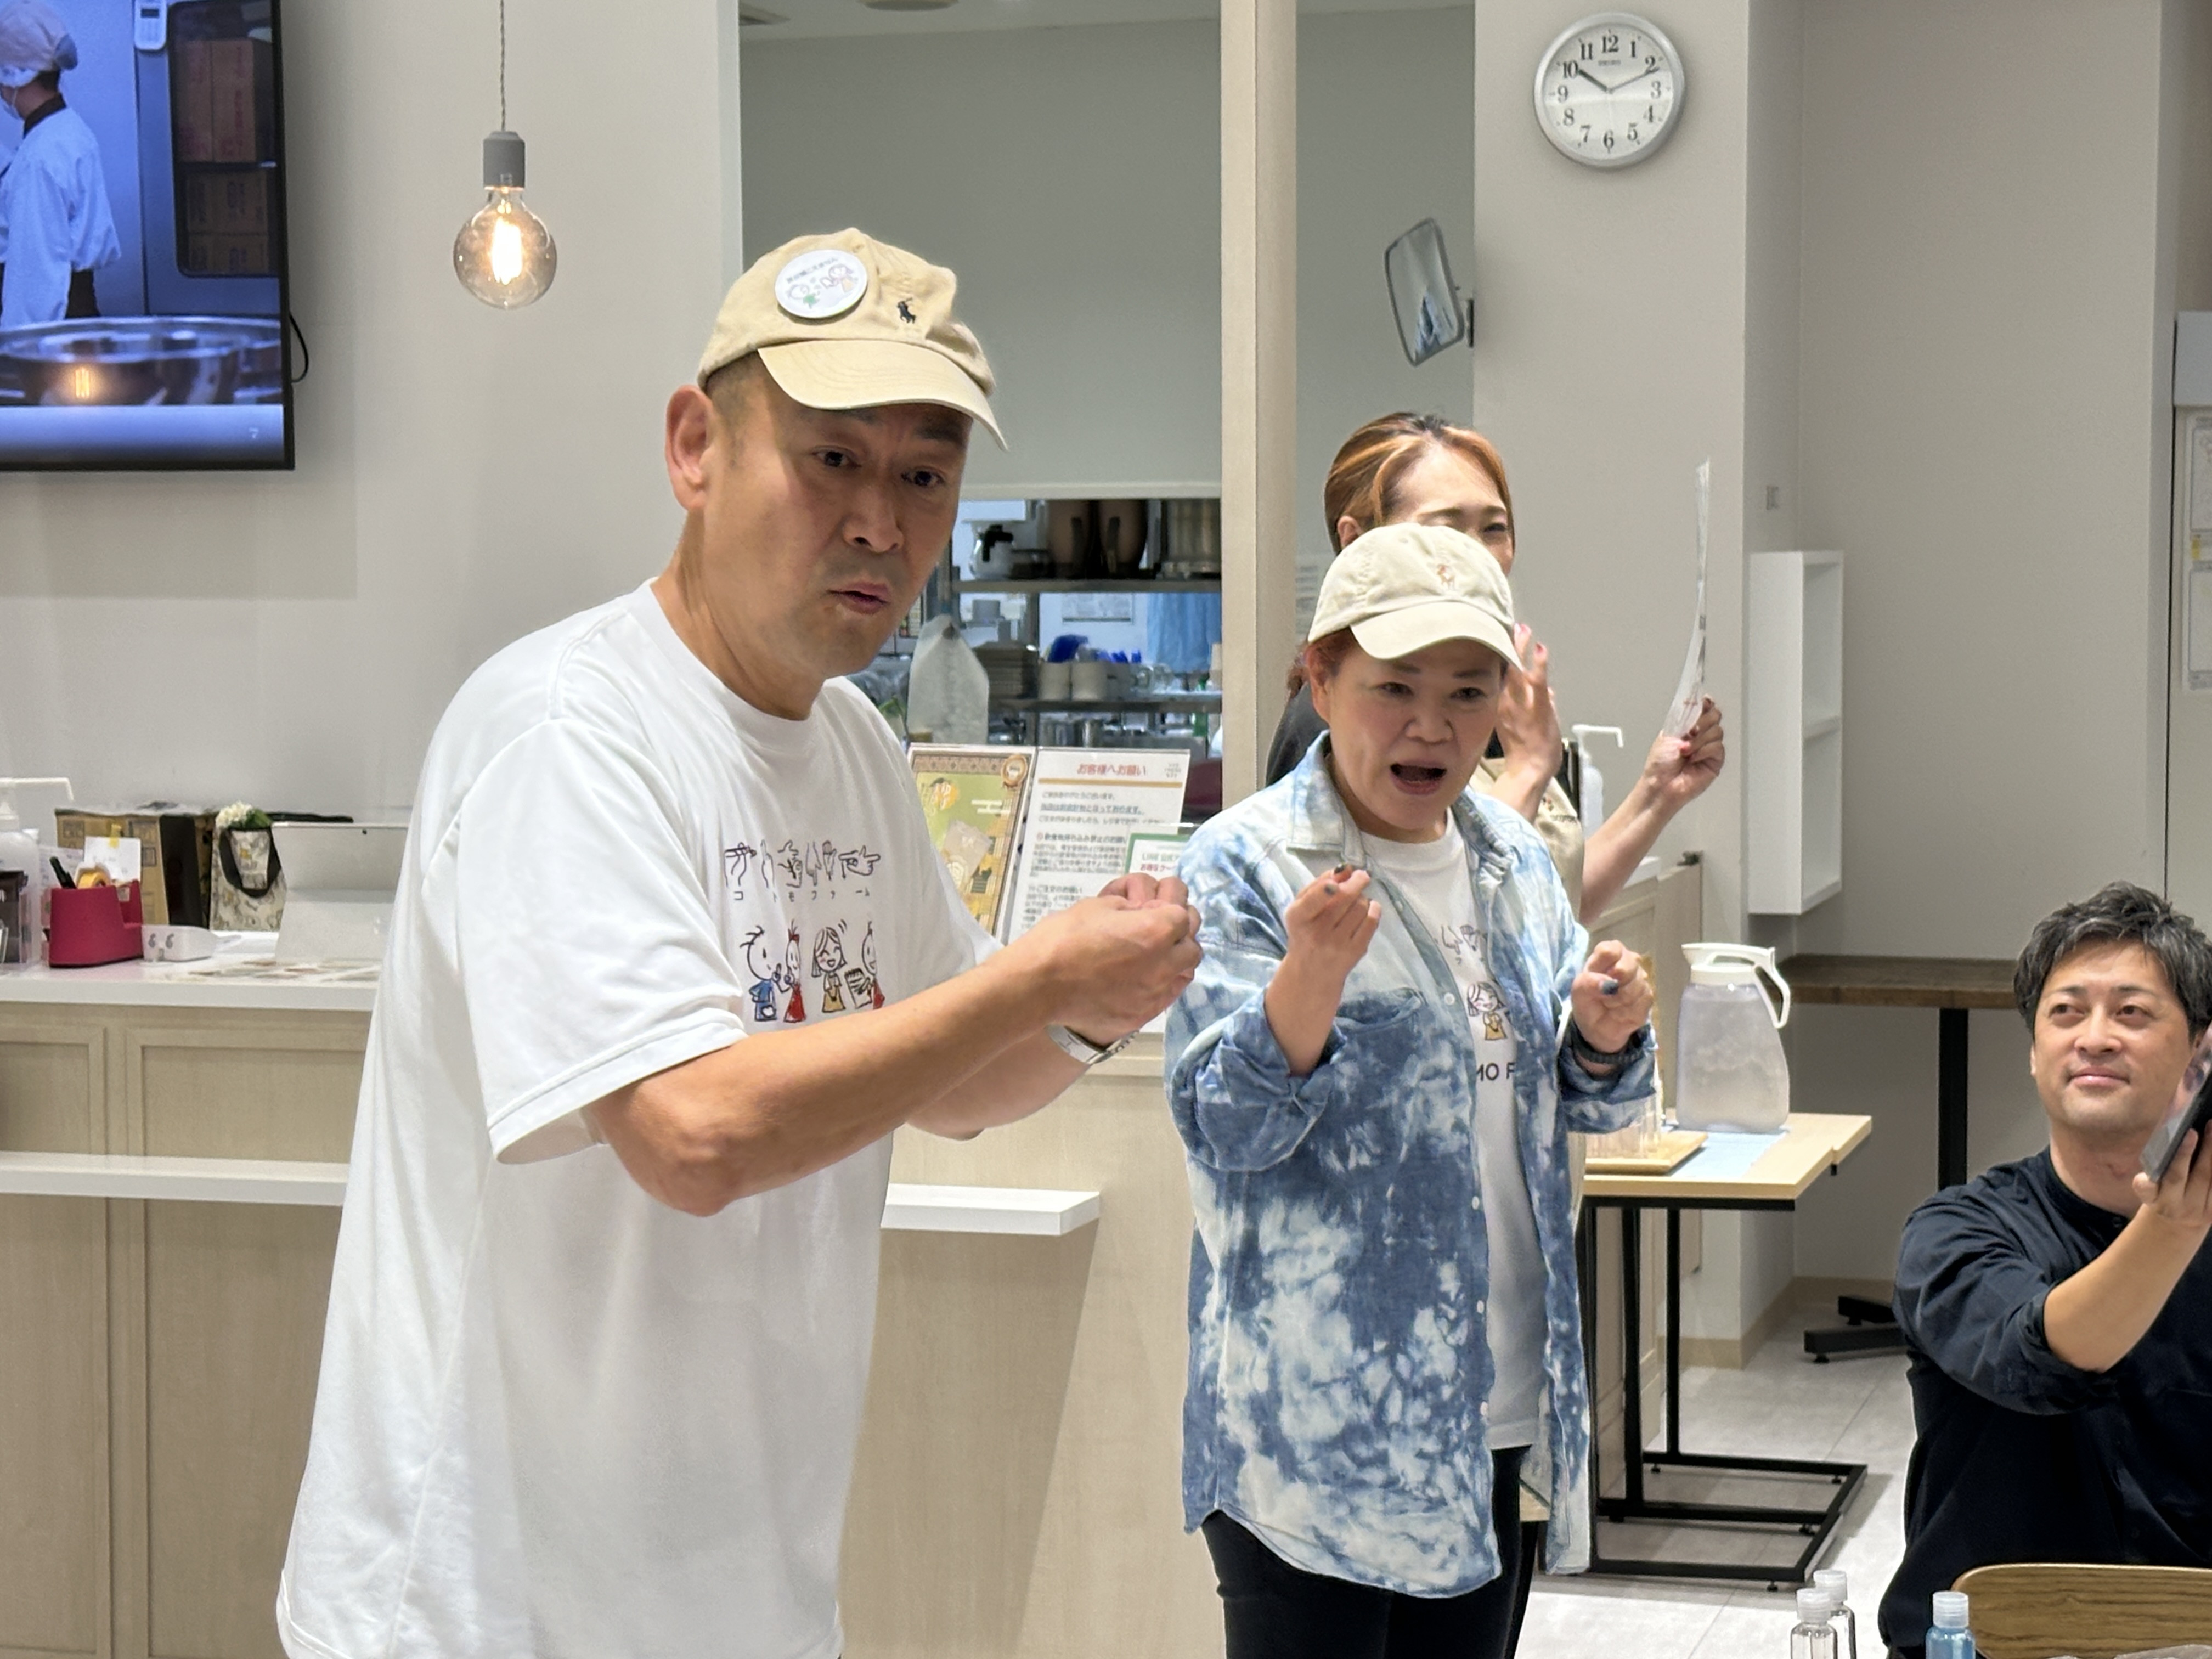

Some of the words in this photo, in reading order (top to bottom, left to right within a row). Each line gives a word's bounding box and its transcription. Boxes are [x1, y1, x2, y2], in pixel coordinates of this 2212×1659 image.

[1581, 43, 1593, 60] 11
[1601, 35, 1618, 53] 12
[1630, 41, 1636, 58] 1
[1564, 60, 1578, 78] 10
[1645, 55, 1659, 74] 2
[1557, 85, 1568, 103] 9
[1651, 81, 1661, 99] 3
[1564, 108, 1575, 126] 8
[1643, 105, 1654, 123] 4
[1580, 125, 1592, 143] 7
[1603, 130, 1614, 149] 6
[1627, 123, 1638, 140] 5
[1077, 763, 1146, 776] お客様へお願い
